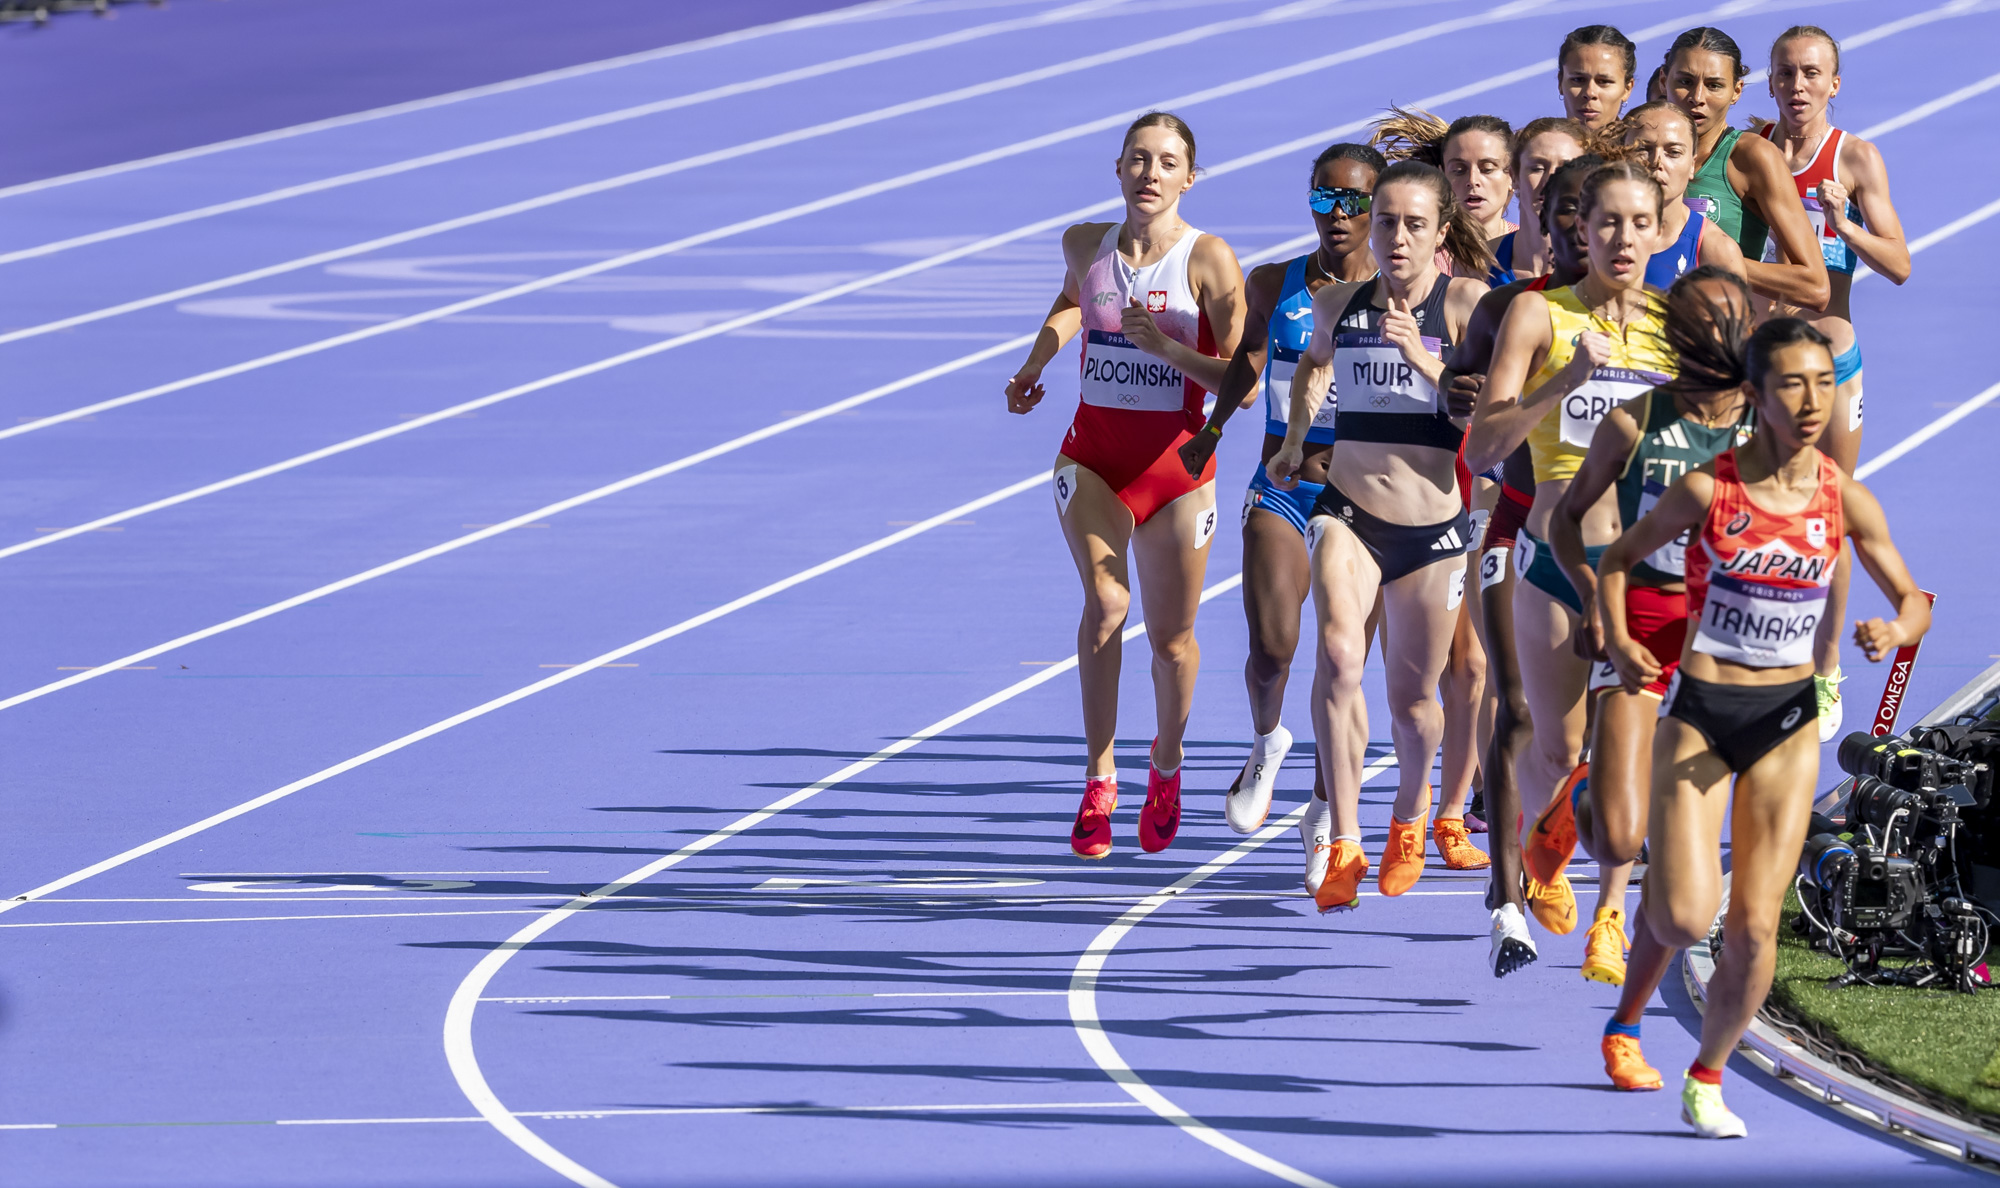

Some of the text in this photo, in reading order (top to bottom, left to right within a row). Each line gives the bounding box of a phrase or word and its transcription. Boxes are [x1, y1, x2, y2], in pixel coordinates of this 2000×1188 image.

[1358, 336, 1382, 344] PARIS
[1353, 362, 1413, 387] MUIR
[1595, 370, 1626, 379] PARIS
[1057, 475, 1068, 500] 8
[1204, 512, 1214, 536] 8
[1721, 550, 1826, 581] JAPAN
[1742, 584, 1775, 599] PARIS
[1709, 601, 1816, 642] TANAKA
[1880, 661, 1911, 721] OMEGA
